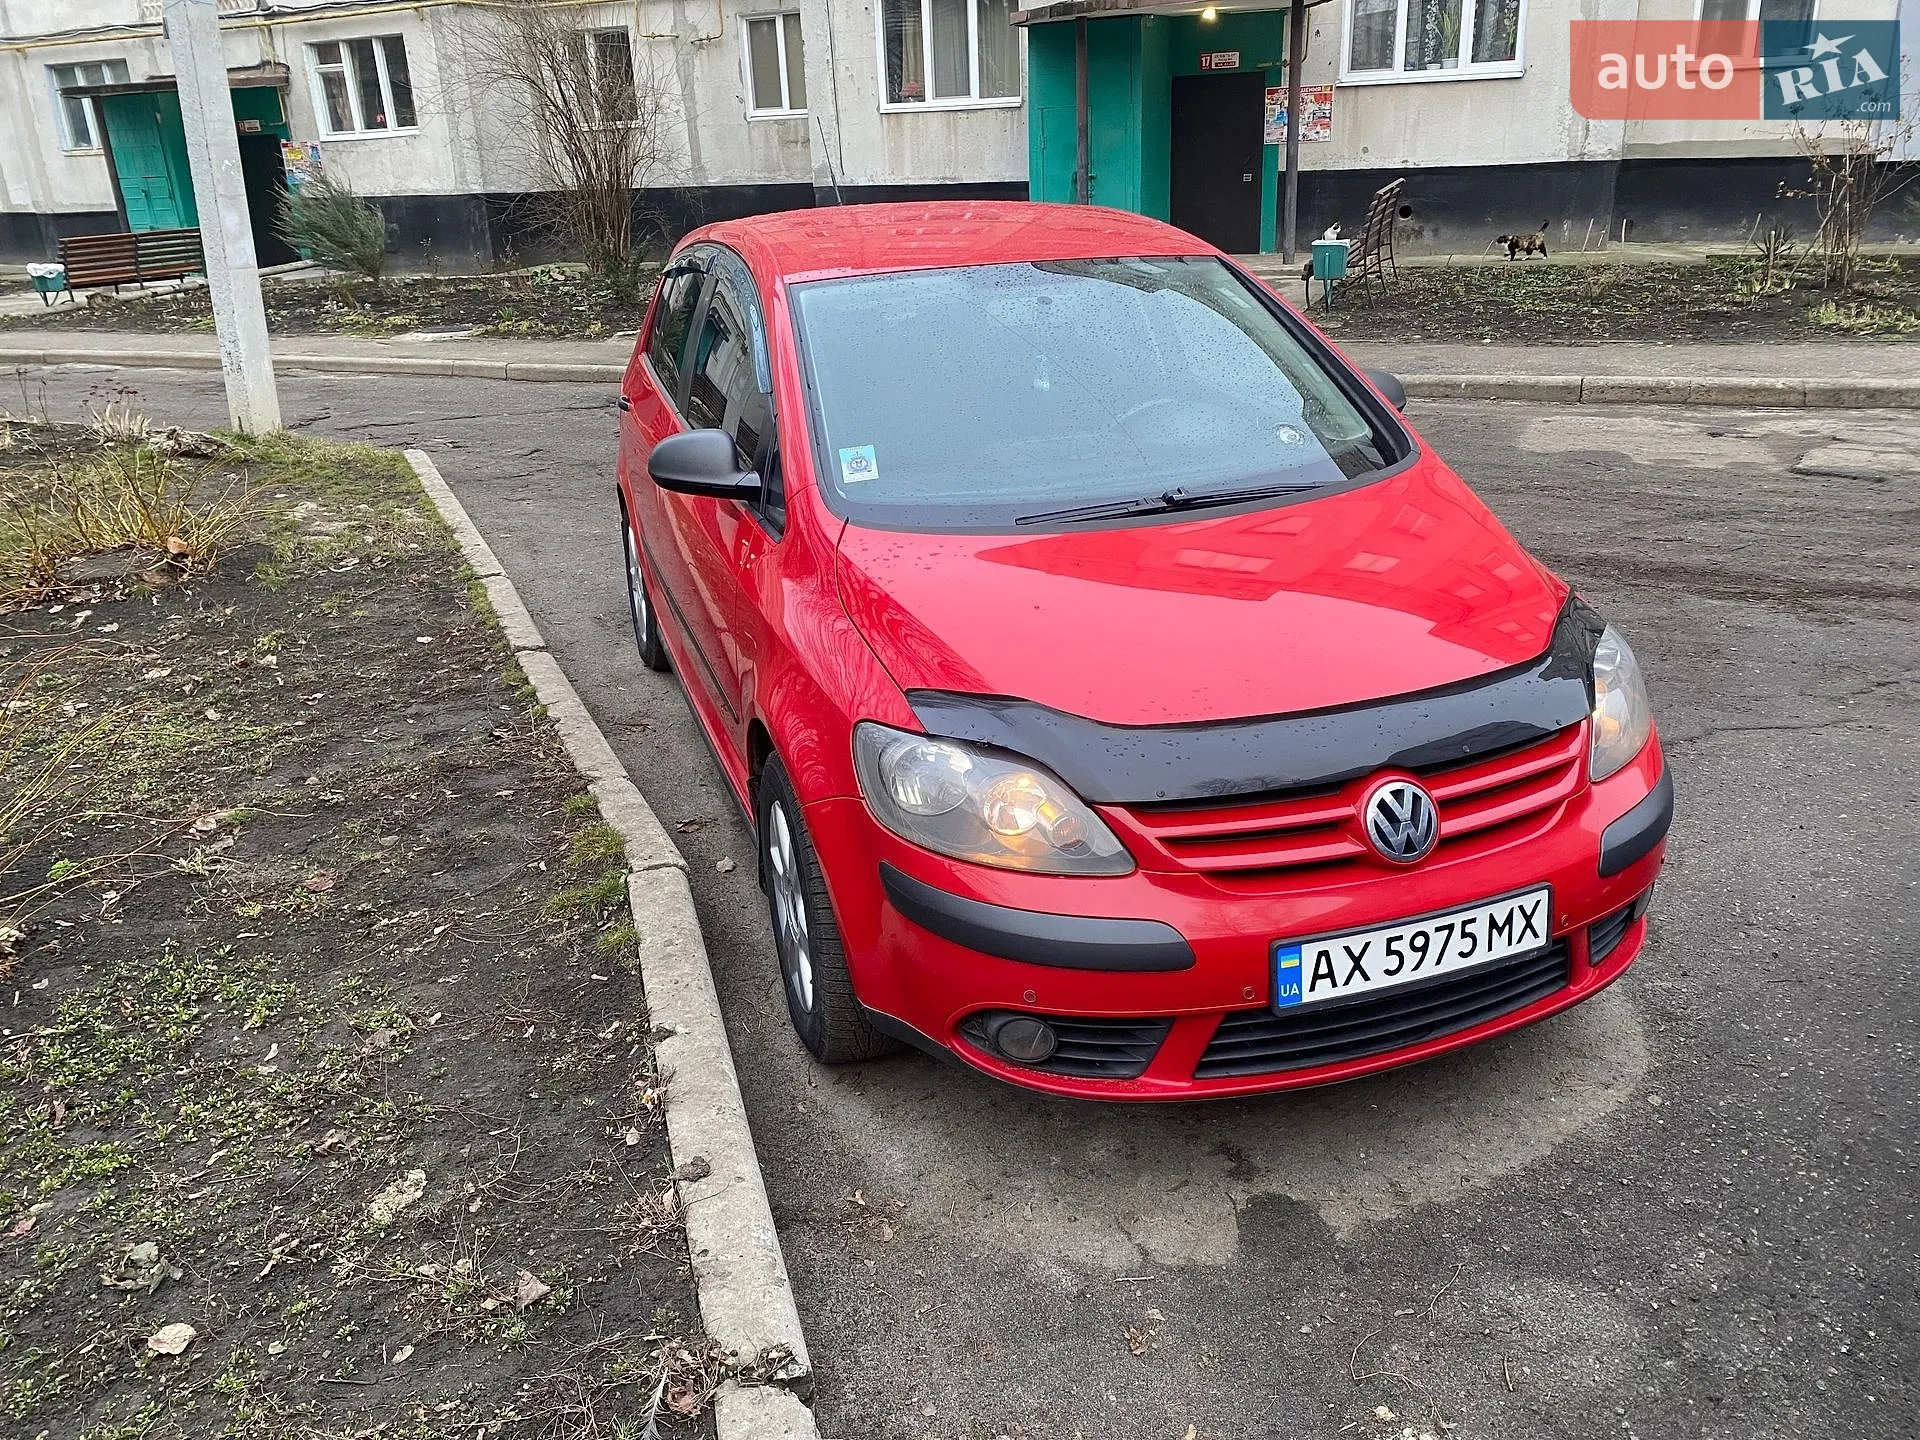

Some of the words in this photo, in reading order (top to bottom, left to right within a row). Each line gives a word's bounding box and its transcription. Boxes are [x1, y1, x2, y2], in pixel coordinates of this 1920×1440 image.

[1201, 56, 1210, 67] 17
[1308, 940, 1372, 993] AX
[1383, 916, 1478, 977] 5975
[1487, 898, 1542, 953] MX
[1280, 983, 1300, 998] UA
